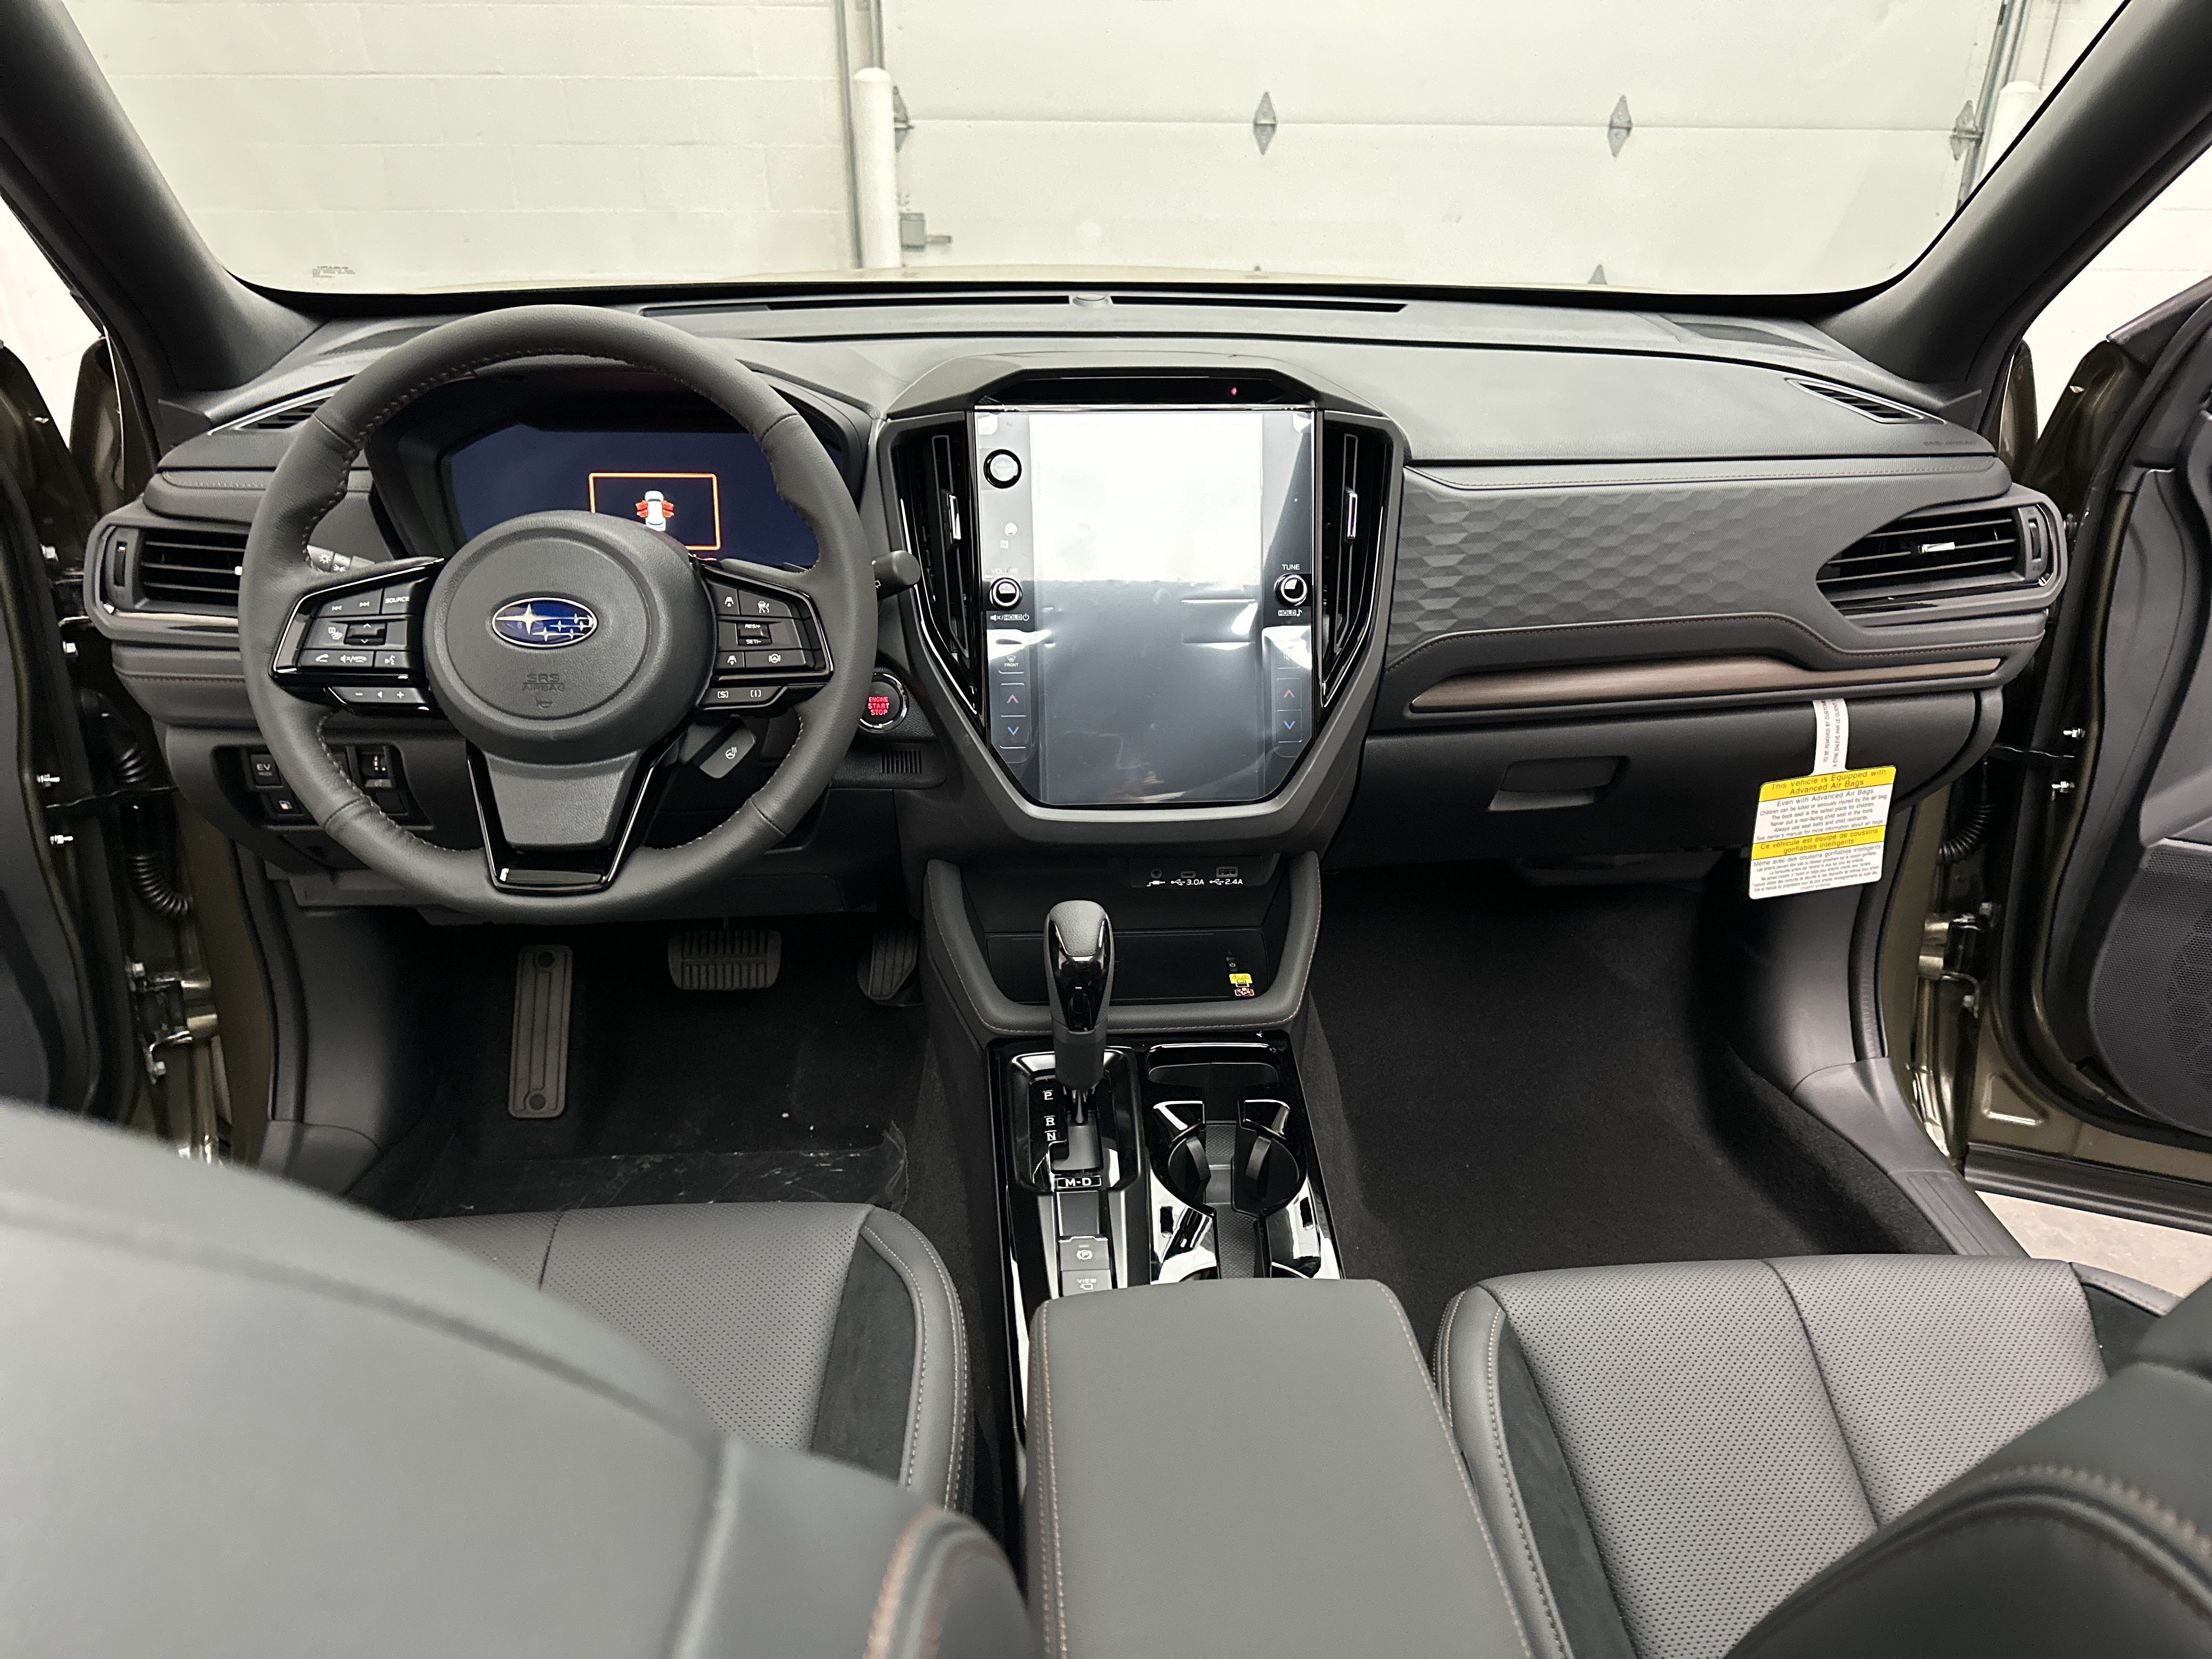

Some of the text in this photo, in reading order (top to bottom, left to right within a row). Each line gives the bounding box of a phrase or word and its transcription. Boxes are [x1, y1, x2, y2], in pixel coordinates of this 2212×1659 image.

[527, 673, 560, 682] SRS
[1791, 778, 1818, 787] Vehicle
[1831, 771, 1867, 781] Equipped
[1790, 784, 1828, 795] Advanced
[1812, 792, 1843, 802] Advanced
[1773, 839, 1800, 848] véhicule
[1815, 834, 1837, 843] équipé
[1850, 828, 1878, 837] coussins
[1783, 839, 1854, 855] gonflables intelligents
[1825, 849, 1852, 858] gonflables
[1044, 1091, 1054, 1101] P
[1046, 1117, 1056, 1126] R
[1047, 1132, 1057, 1141] N
